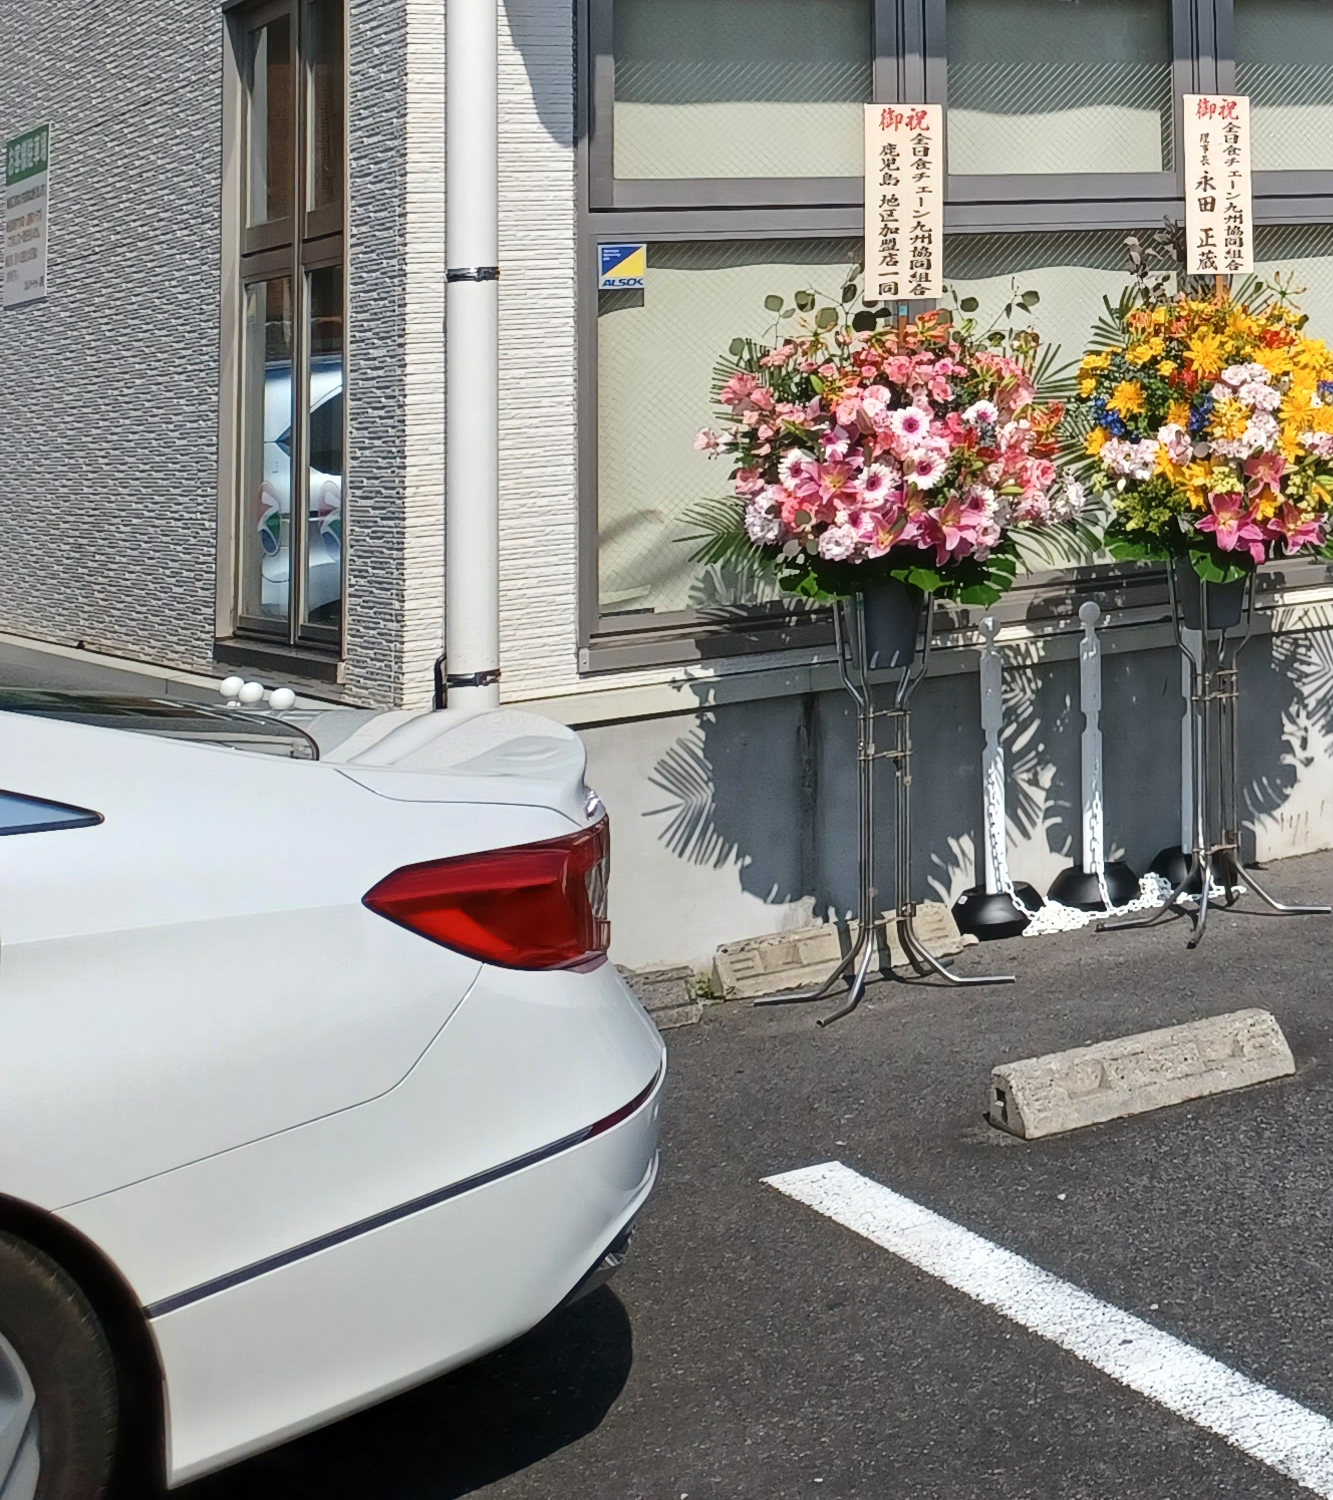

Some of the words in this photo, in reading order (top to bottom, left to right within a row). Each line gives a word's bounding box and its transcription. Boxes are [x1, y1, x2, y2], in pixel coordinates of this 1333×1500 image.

[879, 107, 930, 131] 御祝
[1196, 98, 1239, 121] 御祝
[1222, 122, 1244, 271] 全日食チェーン九州協同組合
[908, 133, 933, 296] 全日食チェーン九州協同組合
[602, 277, 644, 287] ALSOK
